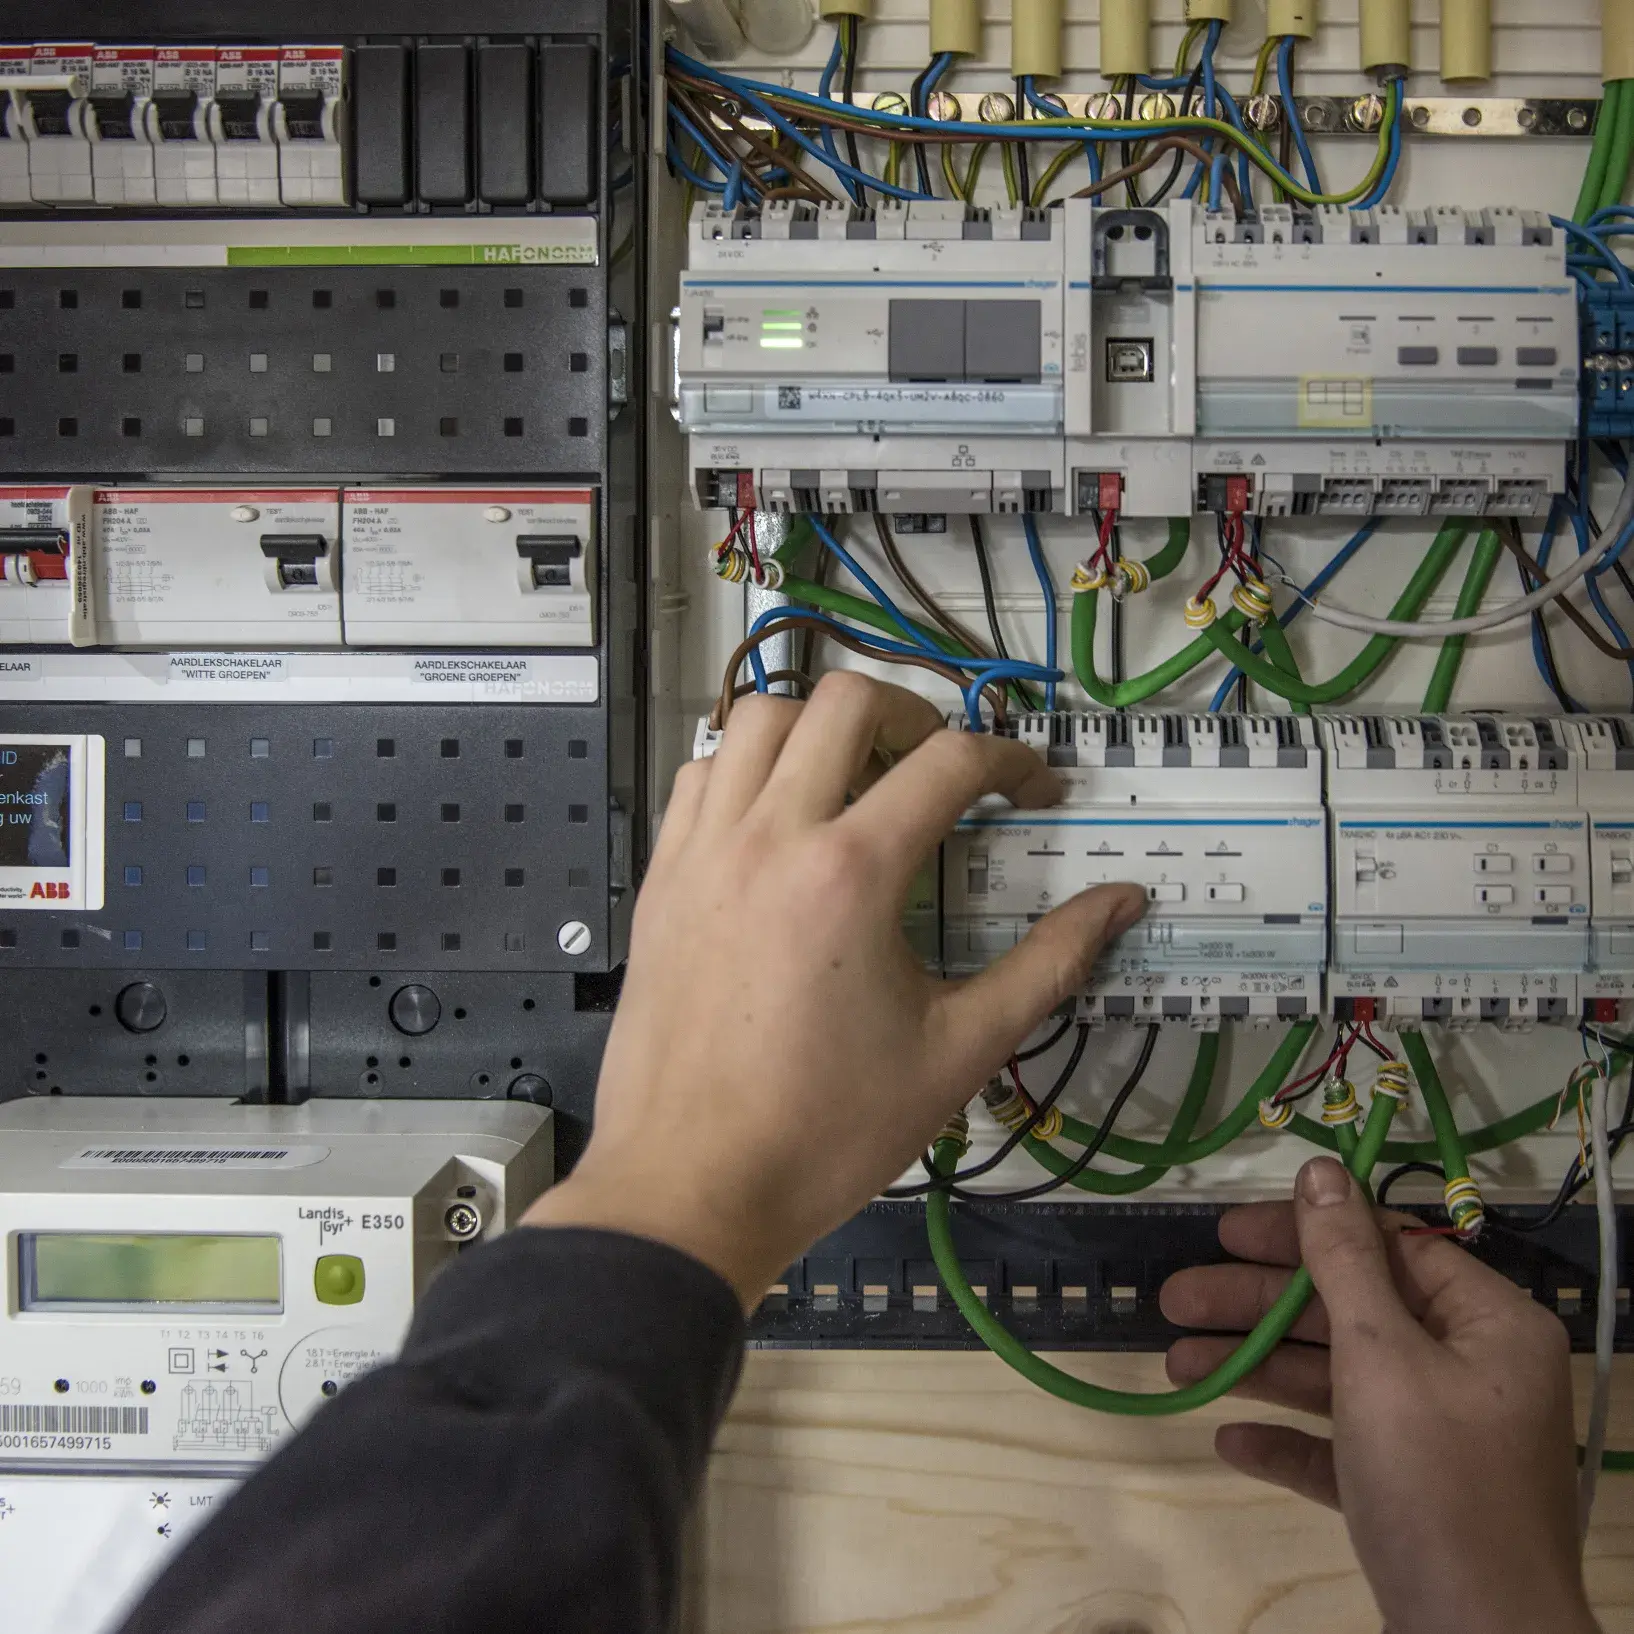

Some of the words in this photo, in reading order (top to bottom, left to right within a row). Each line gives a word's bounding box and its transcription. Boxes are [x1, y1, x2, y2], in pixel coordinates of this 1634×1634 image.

[34, 48, 56, 56] ABB
[96, 51, 118, 59] ABB
[158, 51, 180, 59] ABB
[220, 51, 242, 60] ABB
[284, 50, 306, 59] ABB
[484, 246, 593, 261] HAFONORM
[170, 658, 282, 668] AARDLEKSCHAKELAAR
[414, 660, 527, 670] AARDLEKSCHAKELAAR
[182, 670, 216, 679] "WITTE
[218, 670, 271, 680] GROEPEN"
[420, 672, 466, 682] "GROENE
[468, 672, 522, 682] GROEPEN"
[9, 812, 32, 824] uw
[30, 882, 70, 899] ABB
[298, 1206, 345, 1219] Landis
[362, 1214, 405, 1230] E350
[161, 1329, 171, 1339] T1
[178, 1329, 191, 1340] T2
[198, 1329, 210, 1340] T3
[216, 1330, 228, 1339] T4
[234, 1331, 246, 1340] T5
[252, 1331, 265, 1341] T6
[76, 1380, 108, 1394] 1000
[190, 1496, 214, 1506] LMT
